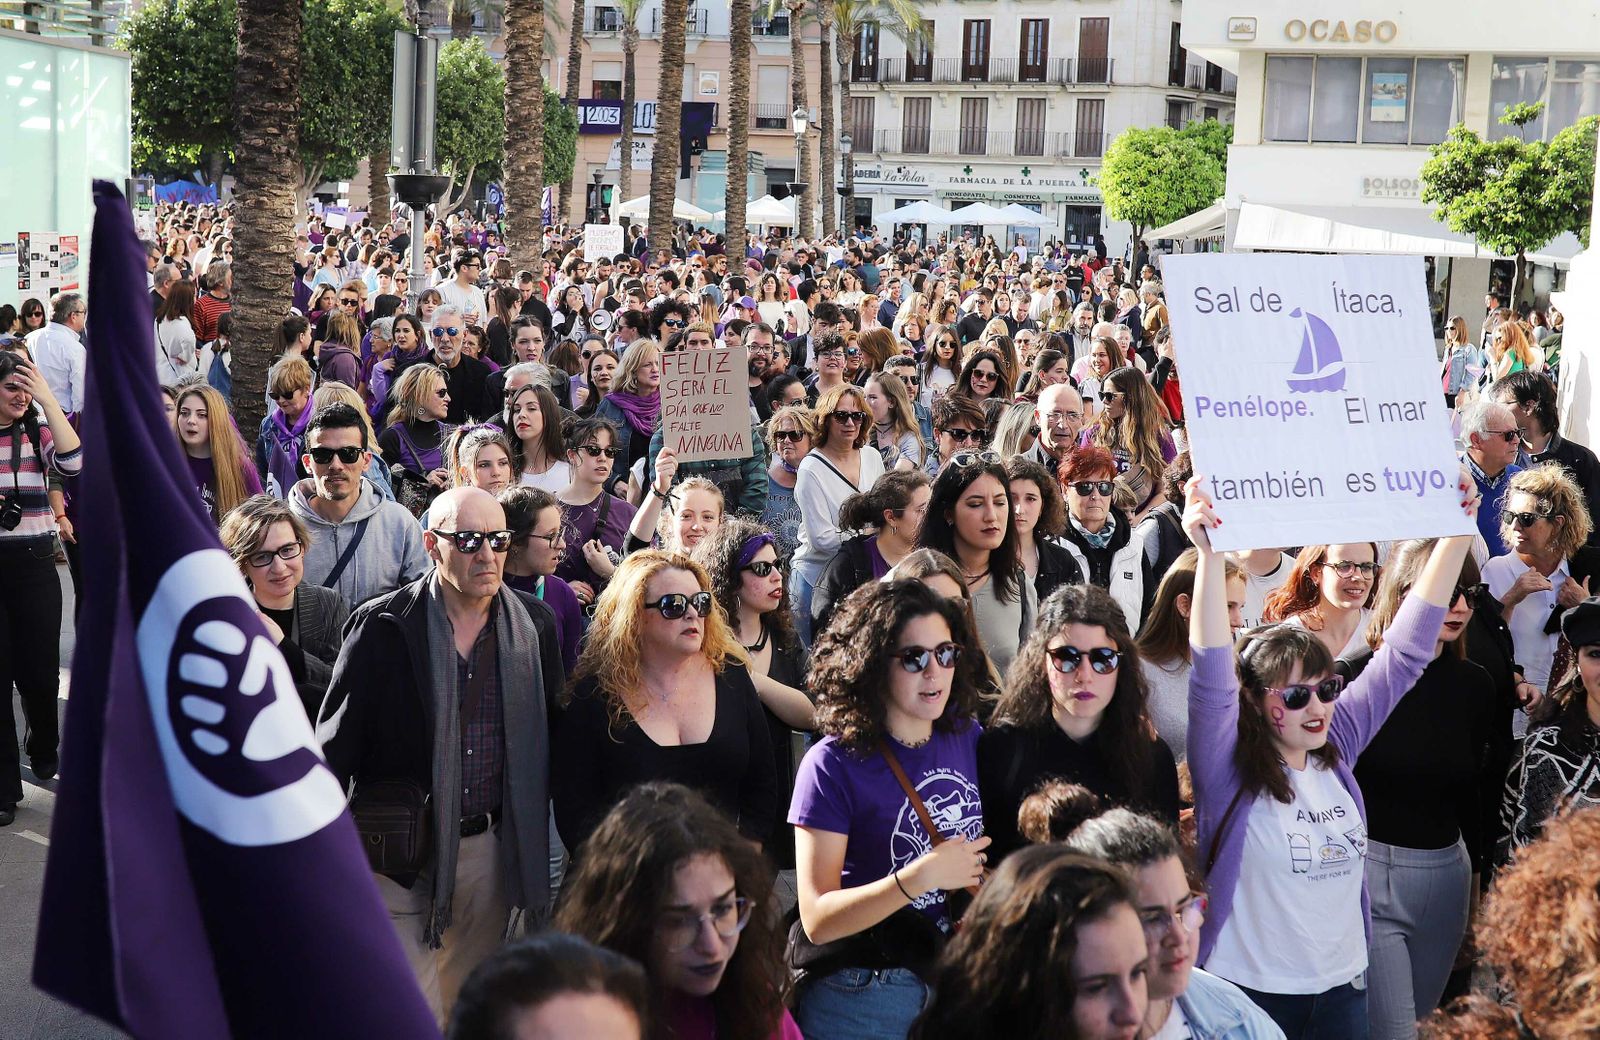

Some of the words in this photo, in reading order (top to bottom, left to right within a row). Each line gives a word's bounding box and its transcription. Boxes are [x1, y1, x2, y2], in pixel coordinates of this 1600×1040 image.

[1284, 19, 1398, 43] OCASO
[882, 168, 897, 182] La
[899, 169, 926, 183] Polar
[949, 176, 997, 185] FARMACIA
[1021, 178, 1033, 186] LA
[1039, 179, 1076, 187] PUERTA
[1363, 177, 1420, 190] BOLSOS
[1194, 286, 1241, 314] Sal
[1250, 286, 1283, 313] de
[1332, 281, 1403, 317] Ítaca,
[661, 352, 732, 376] FELIZ
[666, 375, 706, 399] SERÁ
[713, 379, 732, 395] EL
[665, 400, 687, 417] DÍA
[692, 402, 709, 414] QUE
[709, 403, 725, 414] NO
[1195, 395, 1315, 423] Penélope.
[1344, 397, 1370, 424] El
[1379, 400, 1427, 423] mar
[670, 421, 701, 433] FALTE
[677, 432, 744, 454] NINGUNA
[1211, 470, 1325, 501] también
[1345, 471, 1377, 493] es
[1383, 466, 1454, 498] tuyo.
[1307, 873, 1327, 882] THERE
